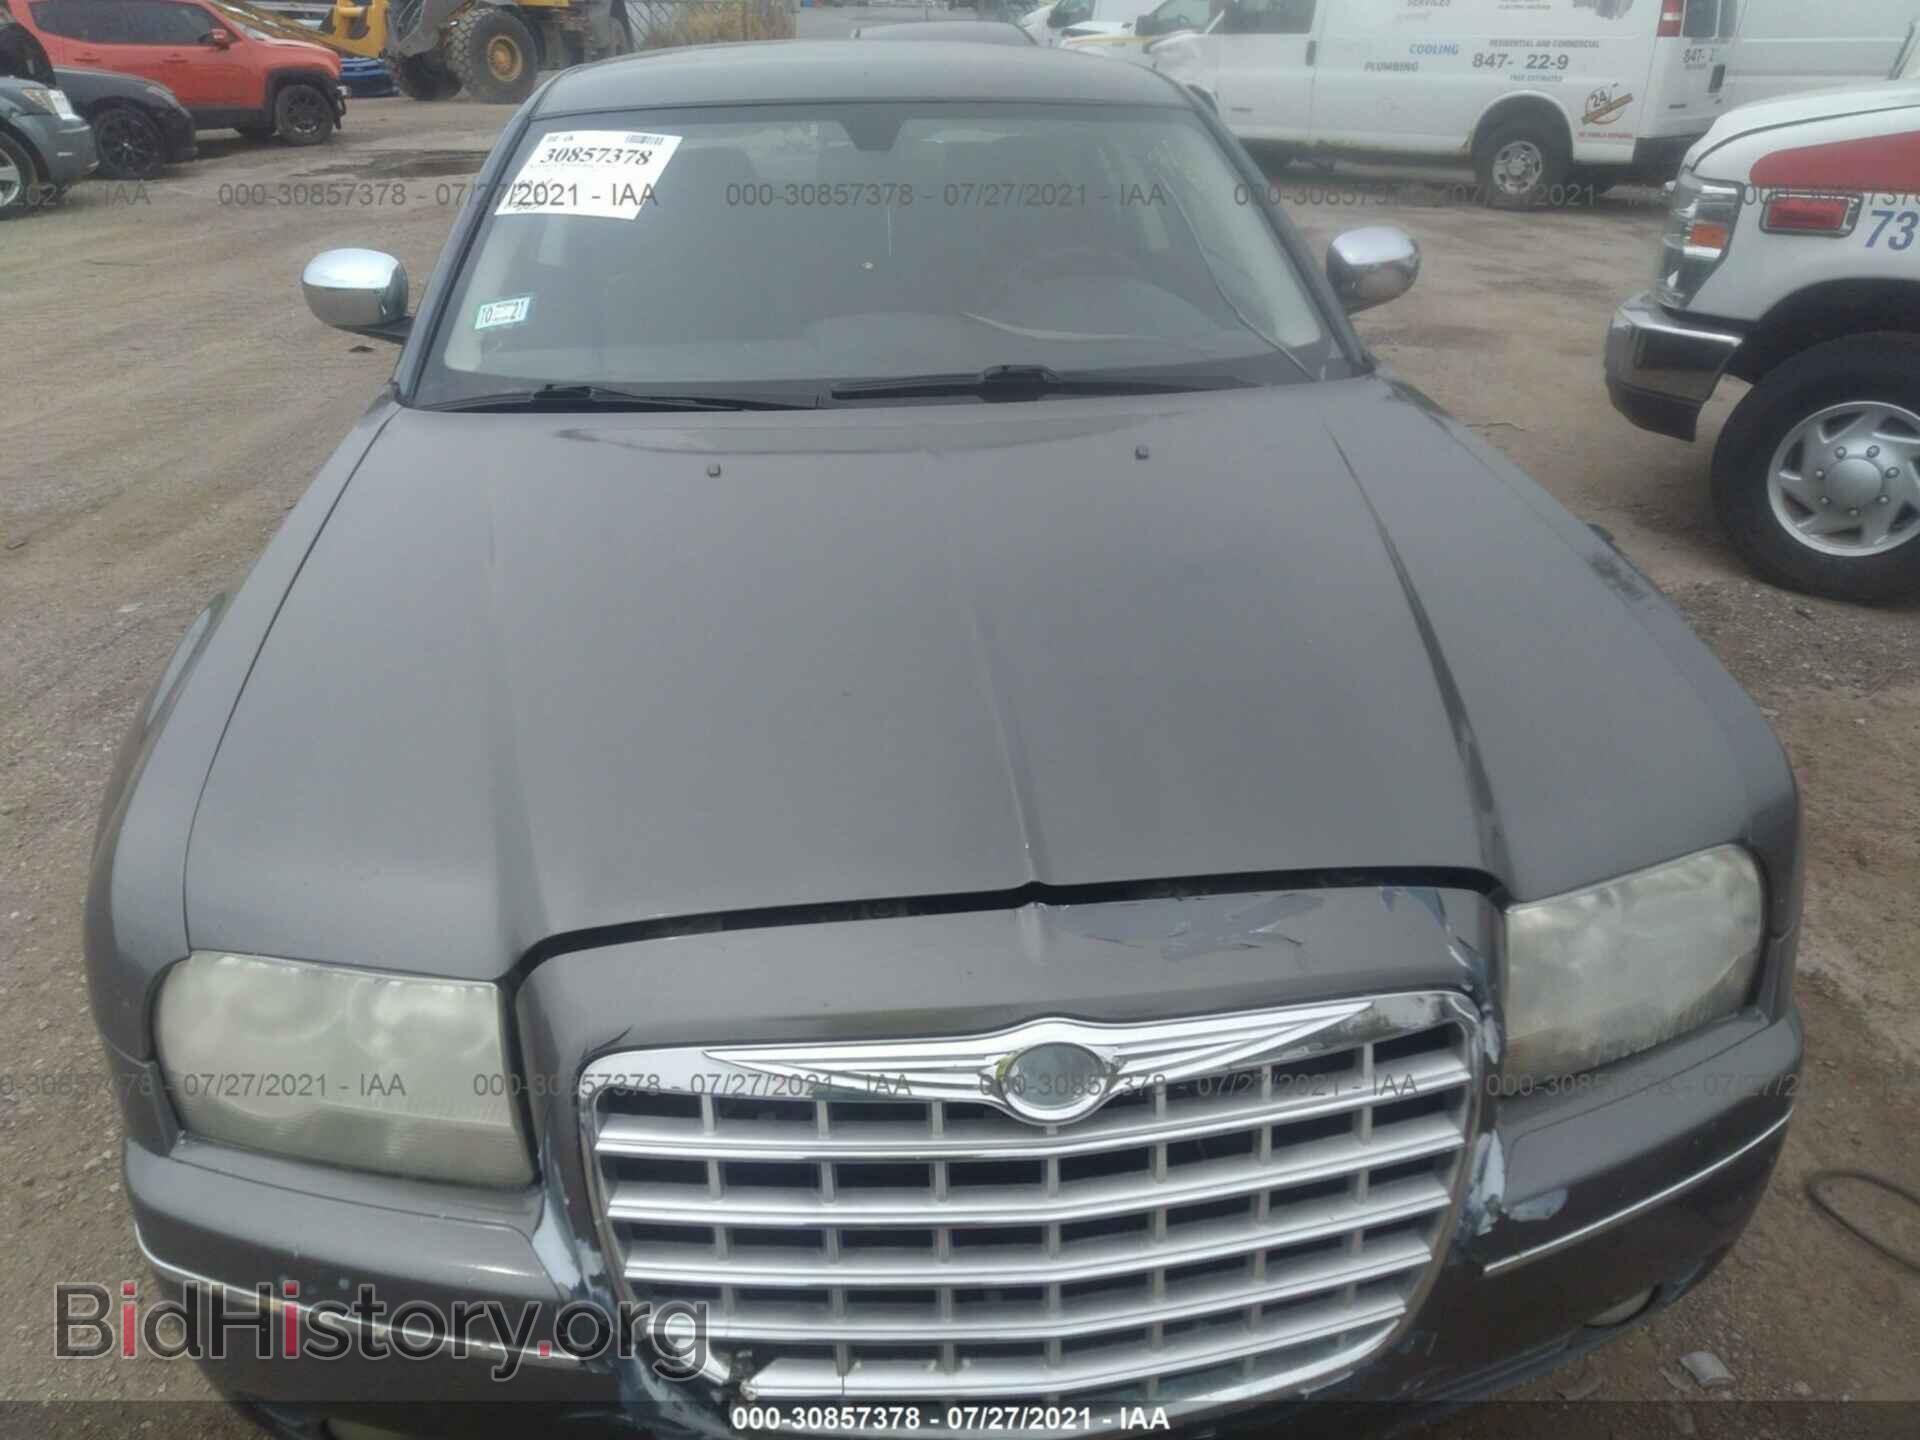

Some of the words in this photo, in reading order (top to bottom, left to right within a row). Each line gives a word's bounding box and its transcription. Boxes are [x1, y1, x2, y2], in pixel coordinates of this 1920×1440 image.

[1409, 43, 1460, 56] COOLING
[1364, 60, 1419, 72] PLUMBING
[1472, 53, 1513, 69] 847-
[1525, 53, 1569, 70] 22-9
[540, 146, 653, 165] 30857378
[1865, 210, 1919, 250] 73
